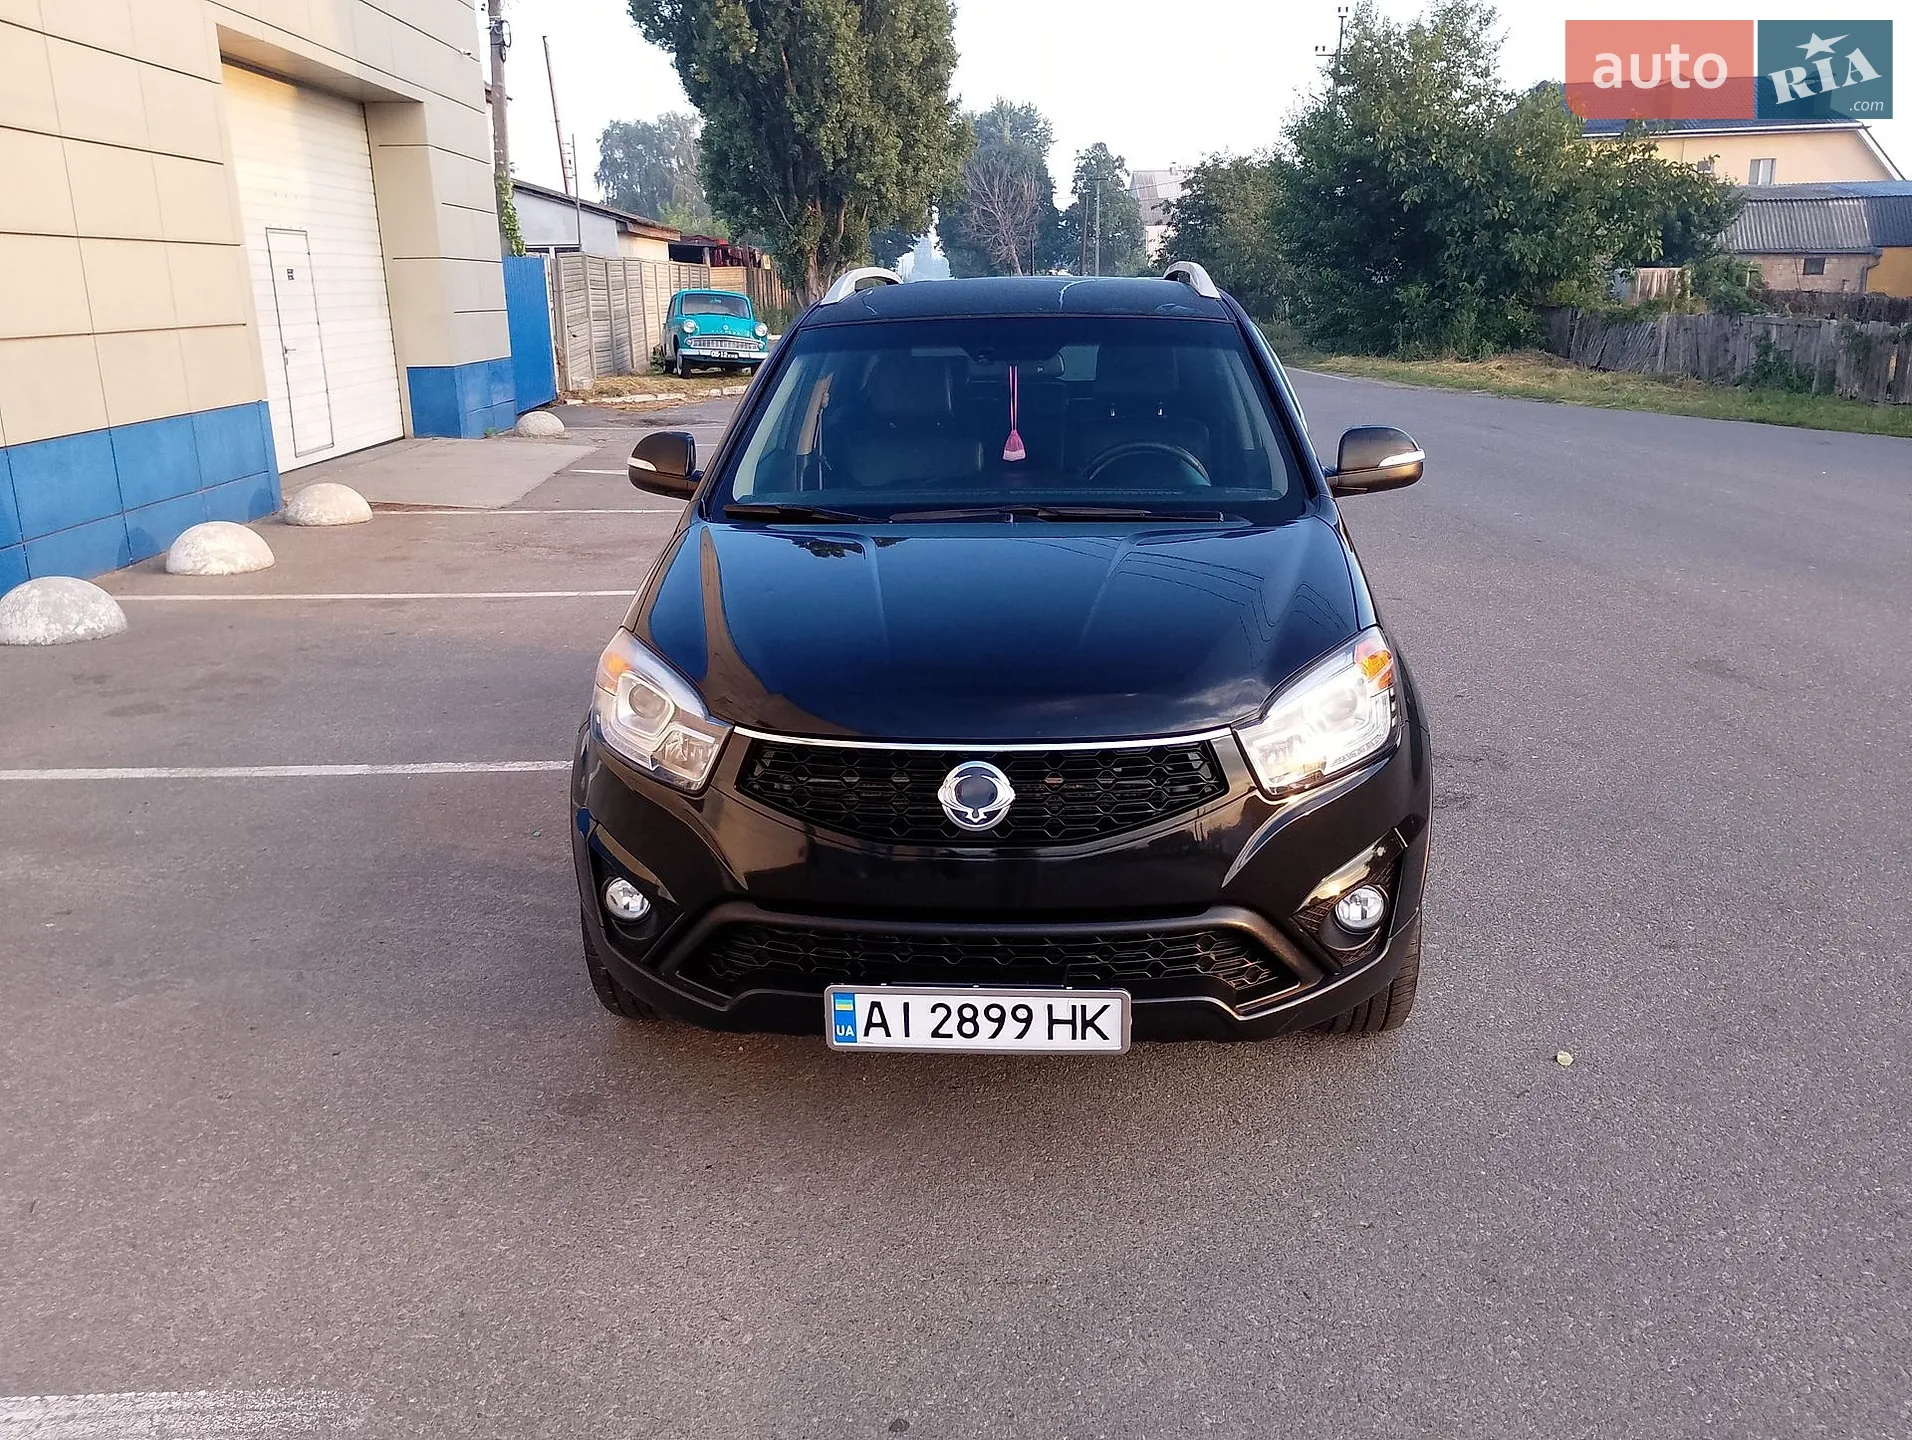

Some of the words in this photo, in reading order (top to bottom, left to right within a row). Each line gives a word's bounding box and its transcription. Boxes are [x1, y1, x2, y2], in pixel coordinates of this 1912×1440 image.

[836, 1024, 855, 1037] UA
[863, 1001, 911, 1038] AI
[930, 1003, 1033, 1039] 2899
[1047, 1004, 1111, 1040] HK
